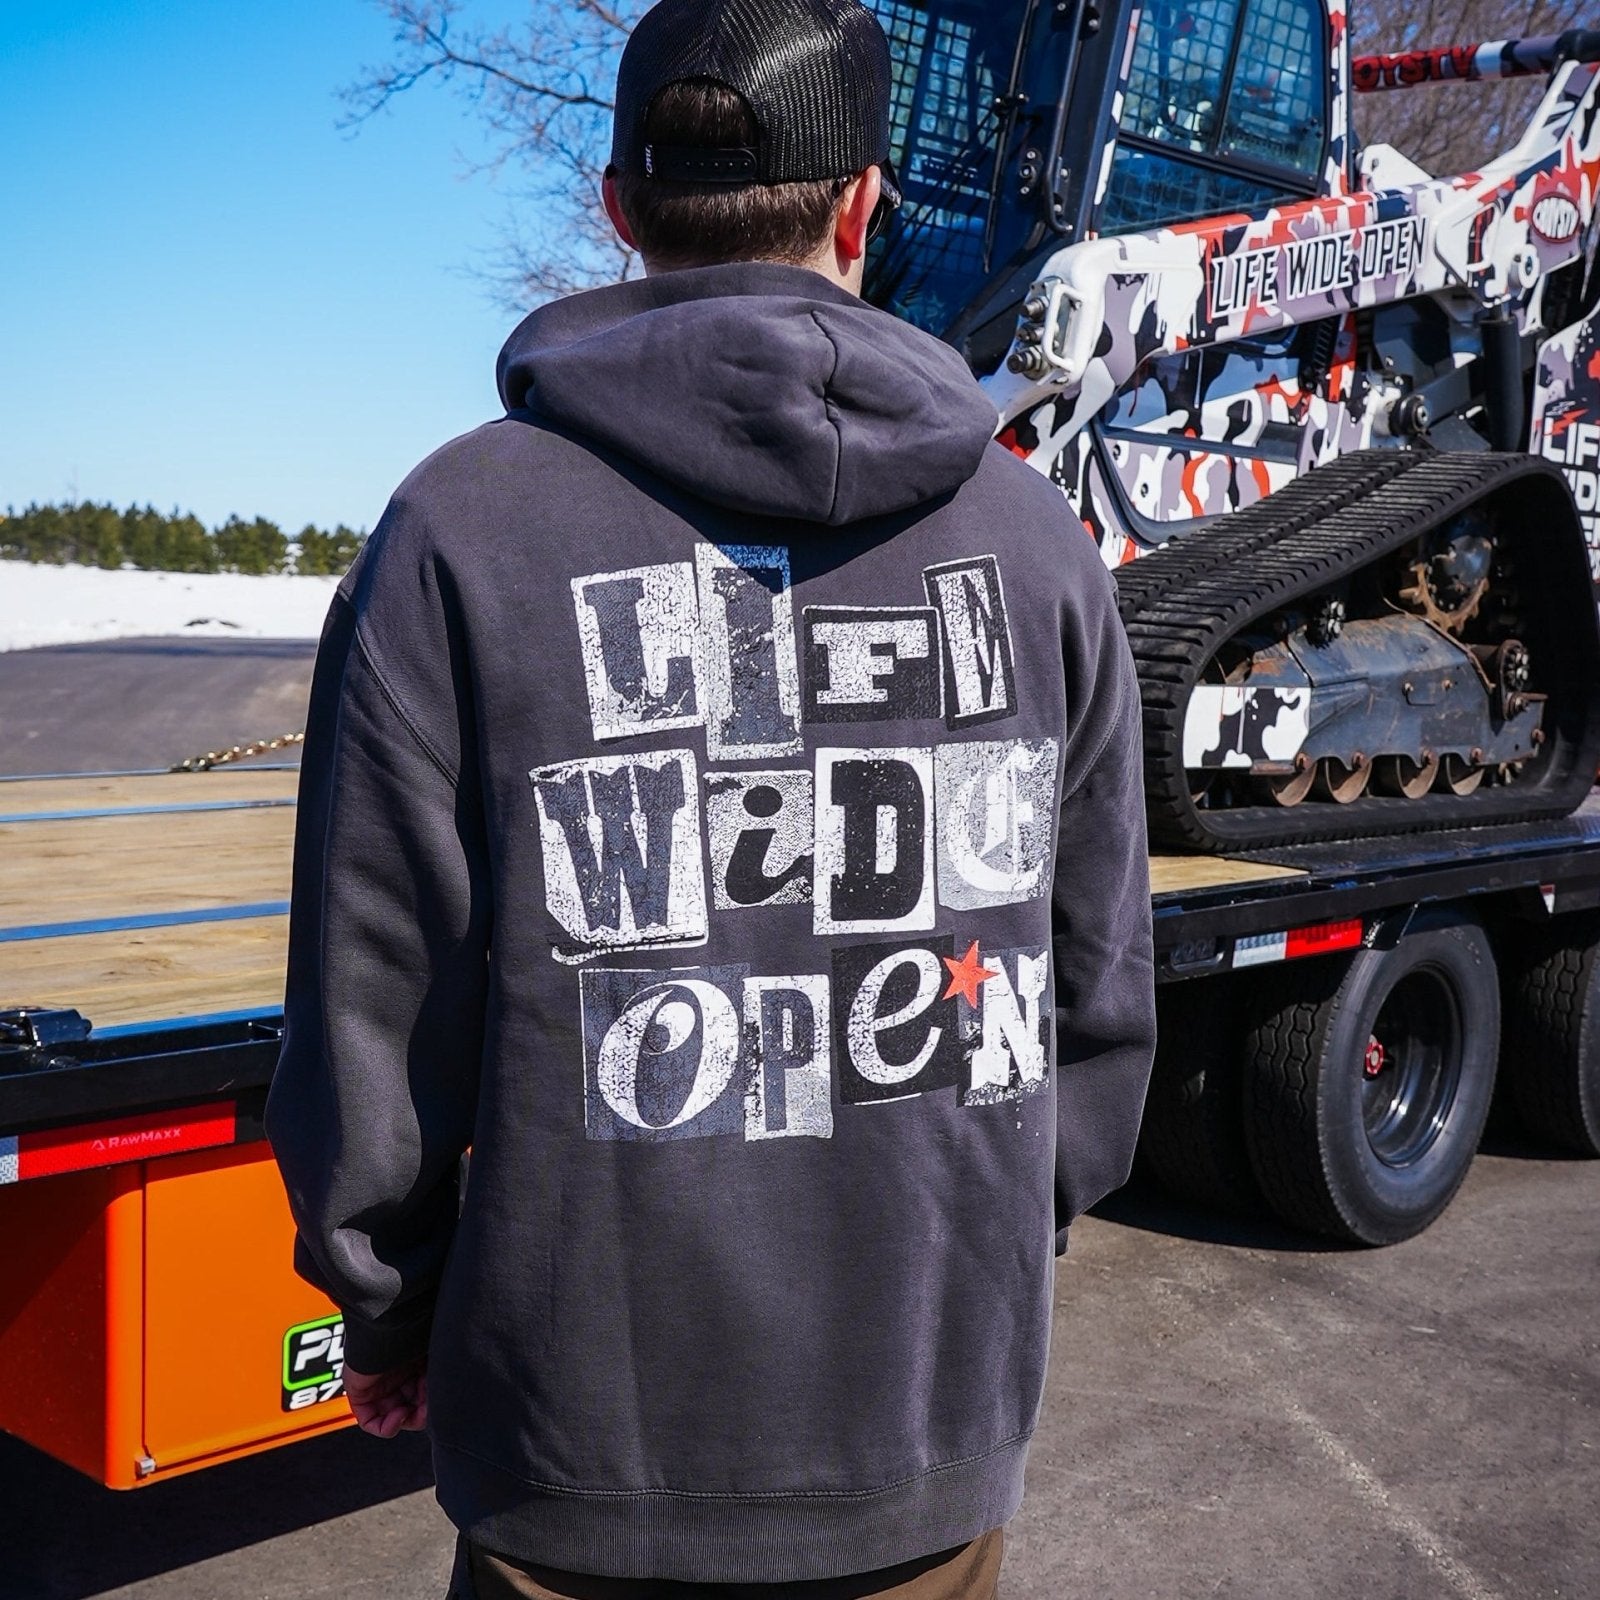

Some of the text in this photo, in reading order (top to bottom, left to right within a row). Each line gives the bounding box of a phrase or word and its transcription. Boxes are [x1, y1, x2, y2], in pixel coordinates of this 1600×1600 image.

[1212, 215, 1428, 318] LIFE WIDE OPEN
[1543, 416, 1600, 466] LIF
[580, 560, 1008, 746] LIFE
[289, 1379, 346, 1410] 87
